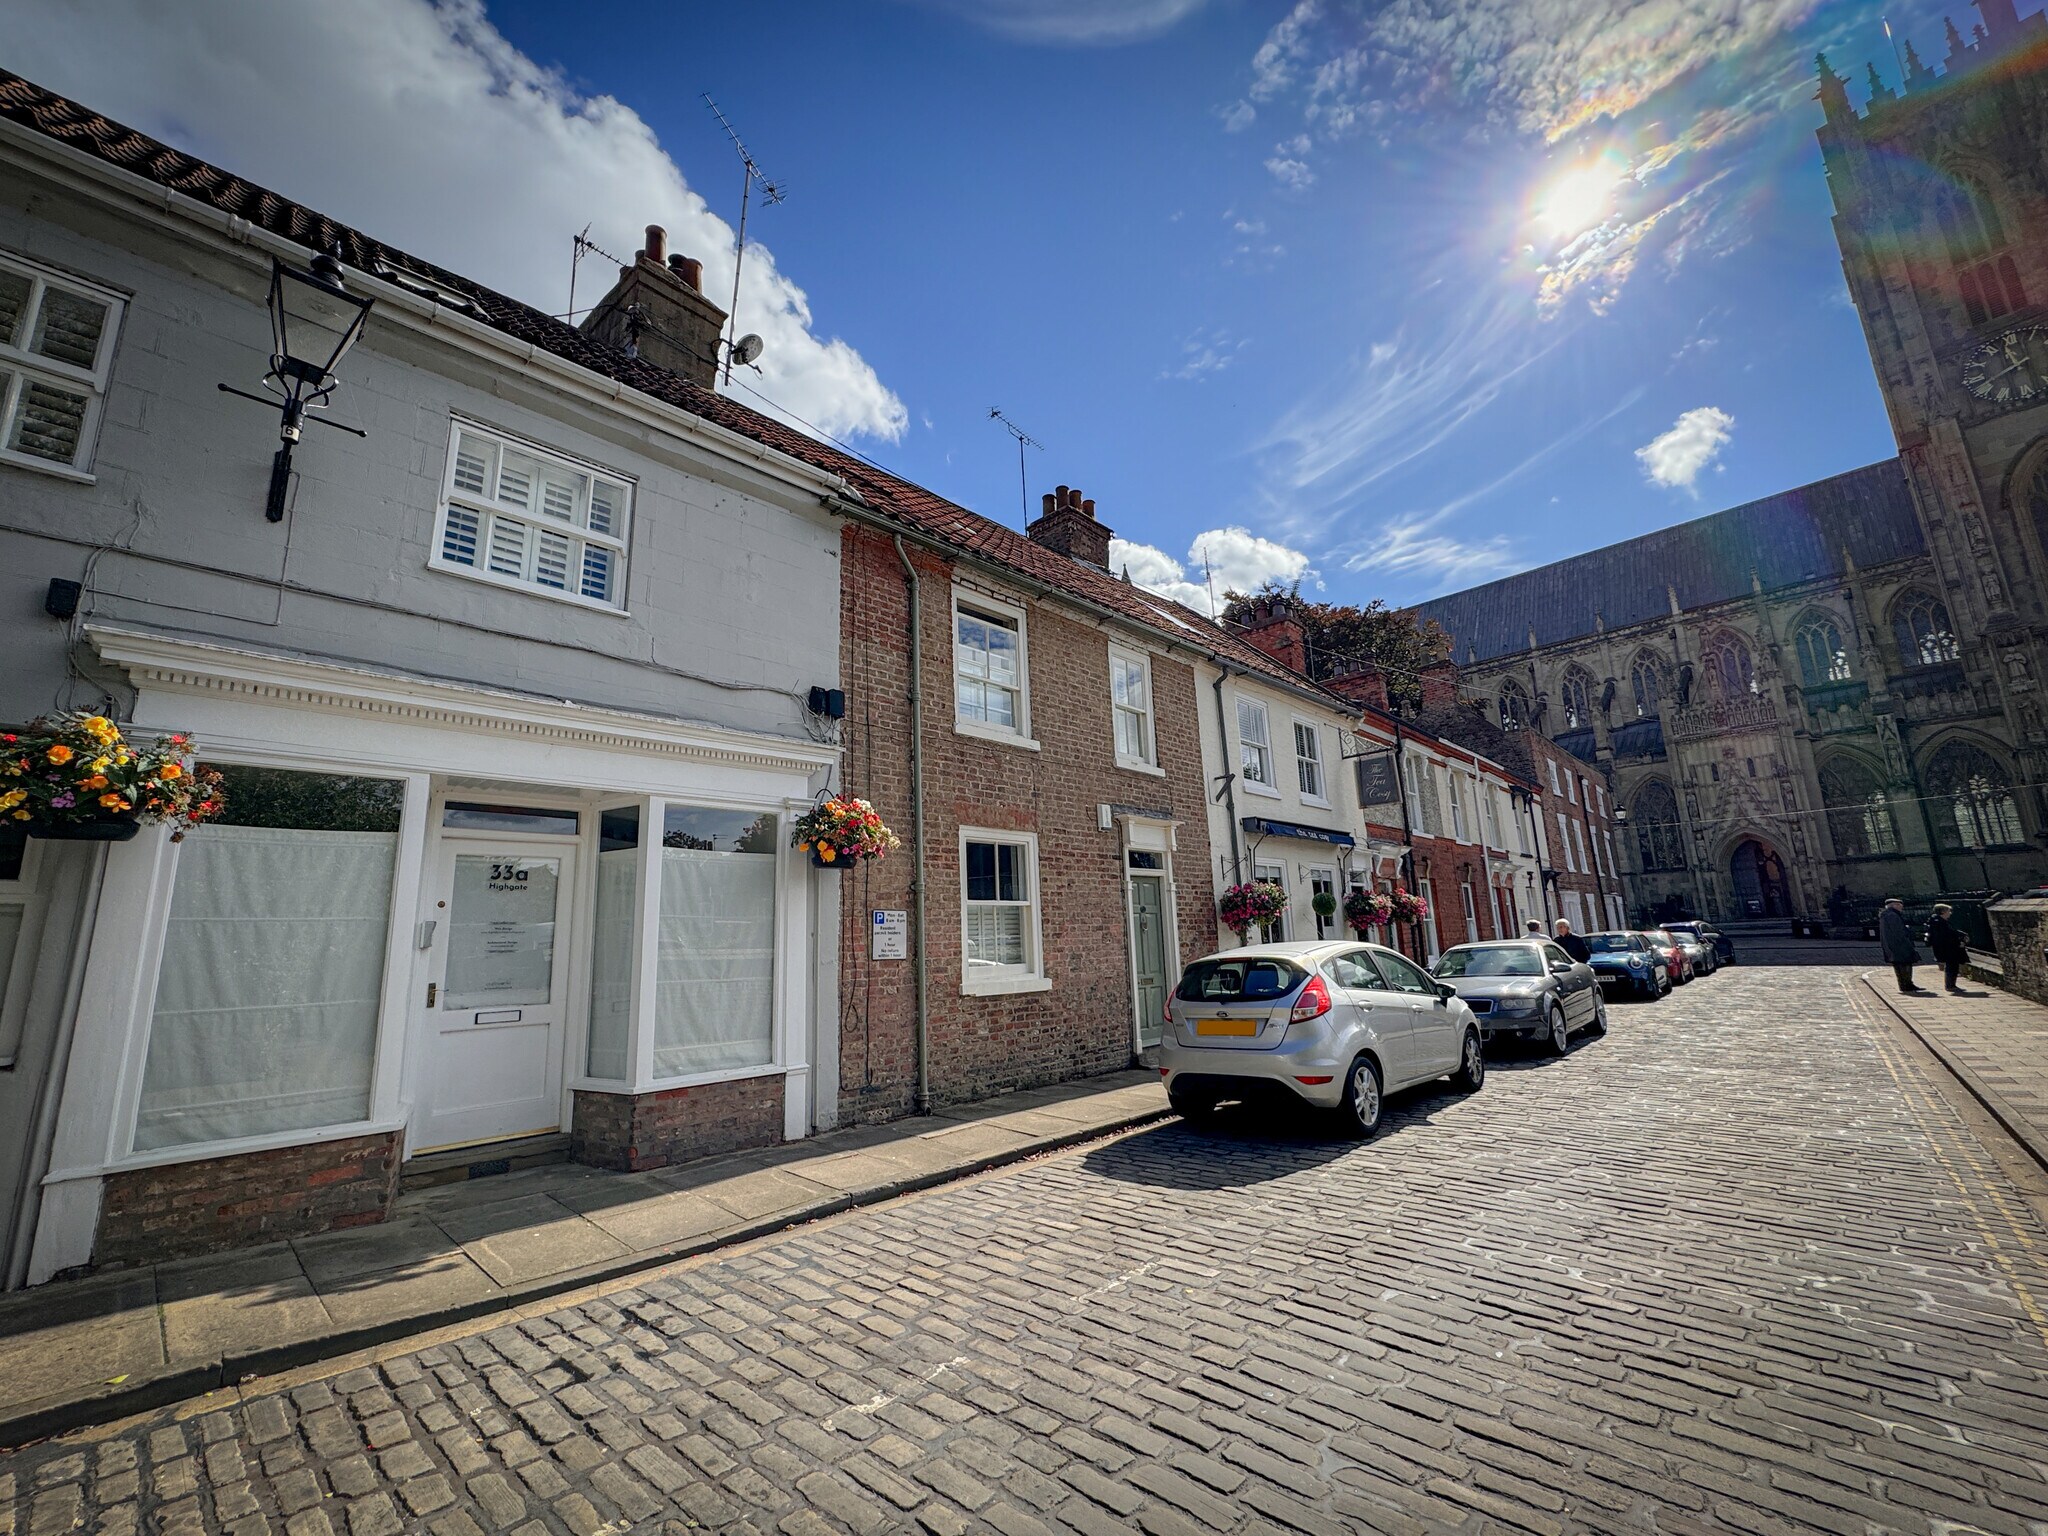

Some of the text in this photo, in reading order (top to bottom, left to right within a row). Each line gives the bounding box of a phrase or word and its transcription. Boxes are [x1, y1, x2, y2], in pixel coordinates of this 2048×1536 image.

[1367, 763, 1383, 774] The
[1366, 774, 1387, 787] Tea
[1366, 787, 1391, 801] Cosy
[490, 864, 529, 881] 33a
[489, 883, 528, 892] Highgate
[877, 913, 884, 923] P
